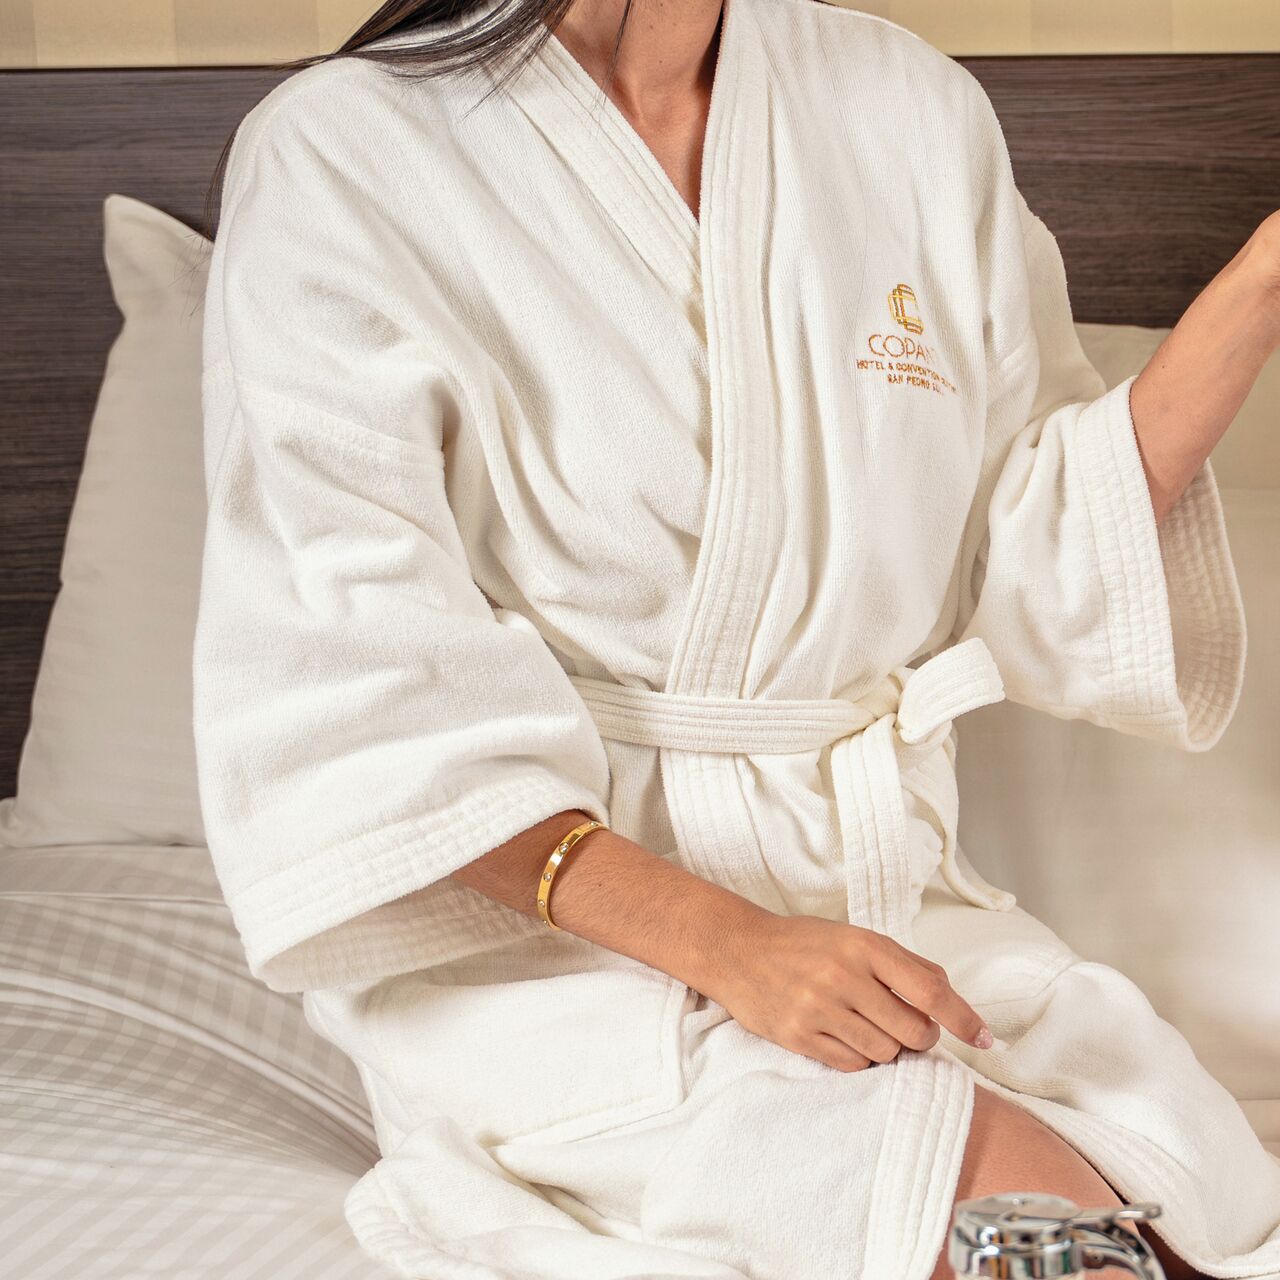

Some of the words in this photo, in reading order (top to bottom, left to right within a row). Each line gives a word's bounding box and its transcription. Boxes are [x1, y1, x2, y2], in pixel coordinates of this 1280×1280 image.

[856, 359, 886, 370] HOTEL
[887, 373, 903, 385] SAN
[906, 375, 930, 390] PEDRO
